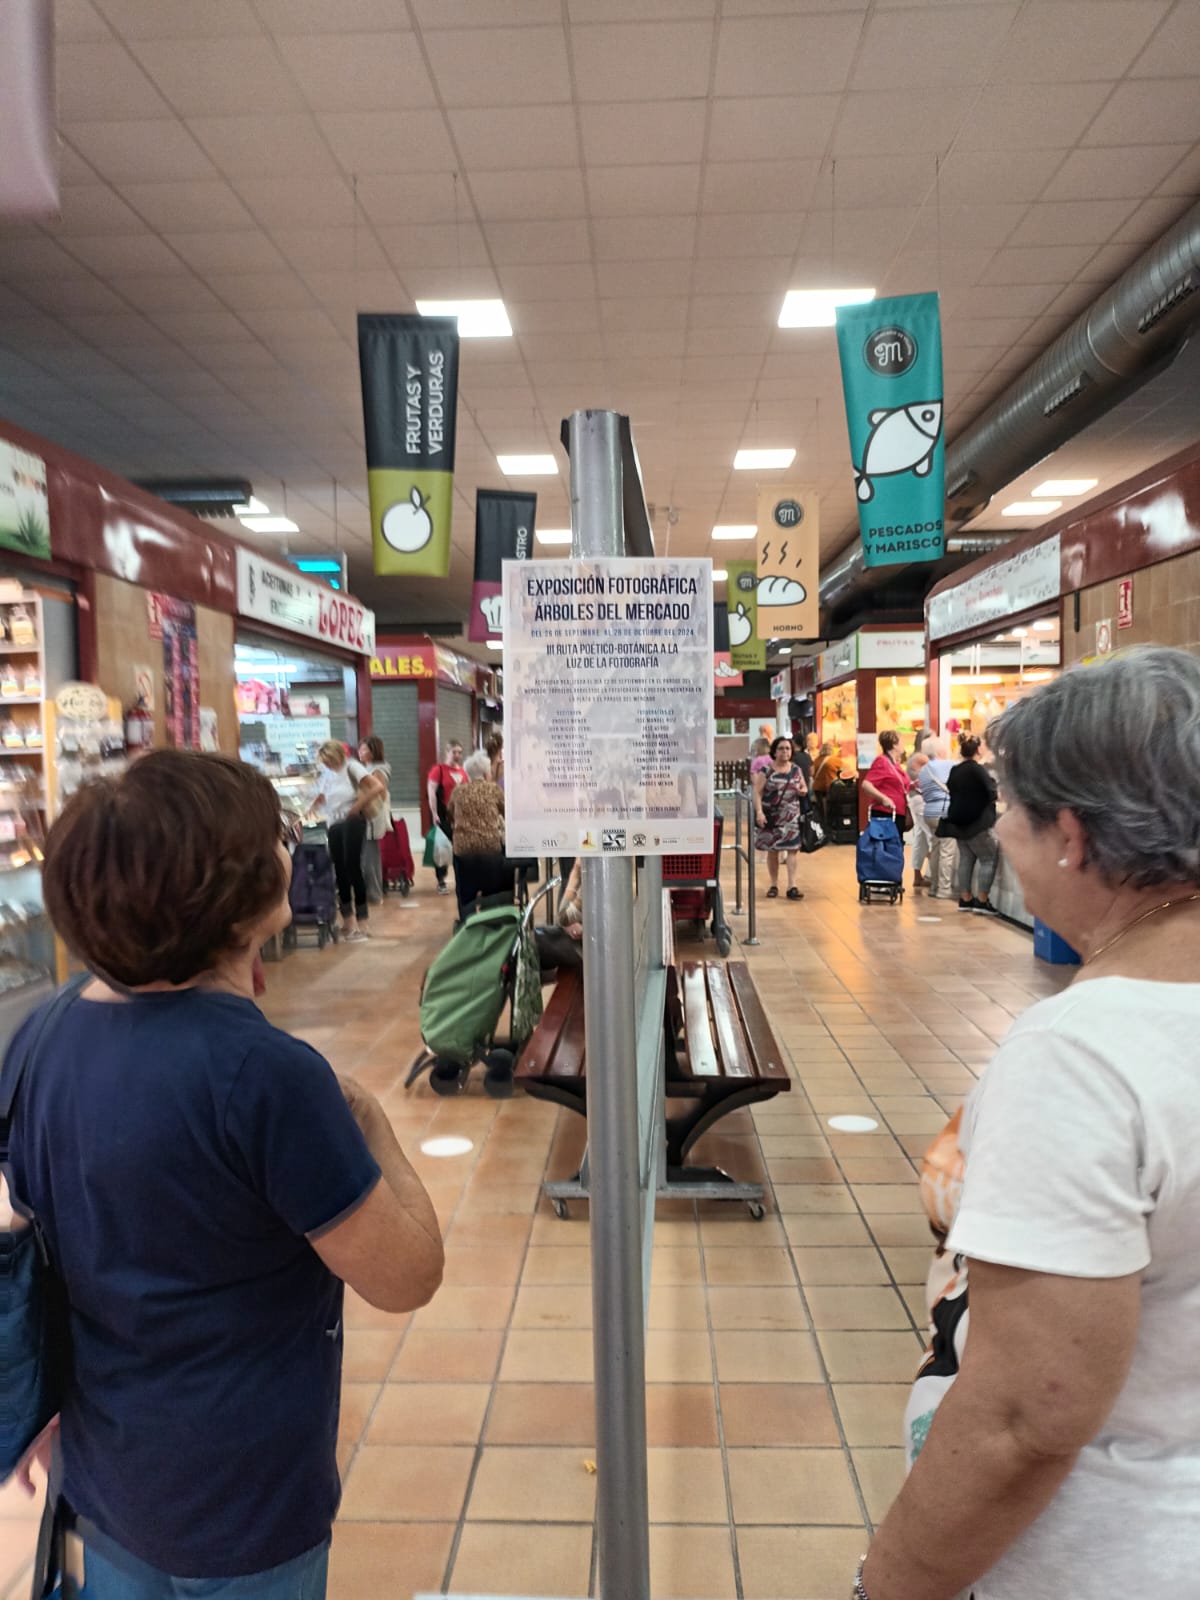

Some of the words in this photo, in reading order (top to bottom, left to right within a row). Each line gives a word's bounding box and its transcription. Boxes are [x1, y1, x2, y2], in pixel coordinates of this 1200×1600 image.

[407, 363, 422, 380] Y
[428, 350, 445, 455] VERDURAS
[406, 379, 422, 455] FRUTAS
[868, 519, 943, 539] PESCADOS
[864, 543, 873, 555] Y
[875, 535, 942, 554] MARISCO
[527, 574, 605, 596] EXPOSICIÓN
[608, 573, 697, 595] FOTOGRÁFICA
[318, 592, 364, 650] LOPEZ
[534, 601, 594, 622] ÁRBOLES
[598, 603, 622, 621] DEL
[626, 602, 690, 621] MERCADO
[678, 628, 694, 636] 2024
[772, 624, 804, 632] HORNO
[547, 644, 555, 656] III
[556, 644, 579, 655] RUTA
[660, 643, 666, 655] A
[668, 643, 679, 654] LA
[566, 658, 582, 669] LUZ
[584, 658, 595, 668] DE
[597, 657, 607, 668] LA
[608, 655, 659, 668] FOTOGRAFÍA
